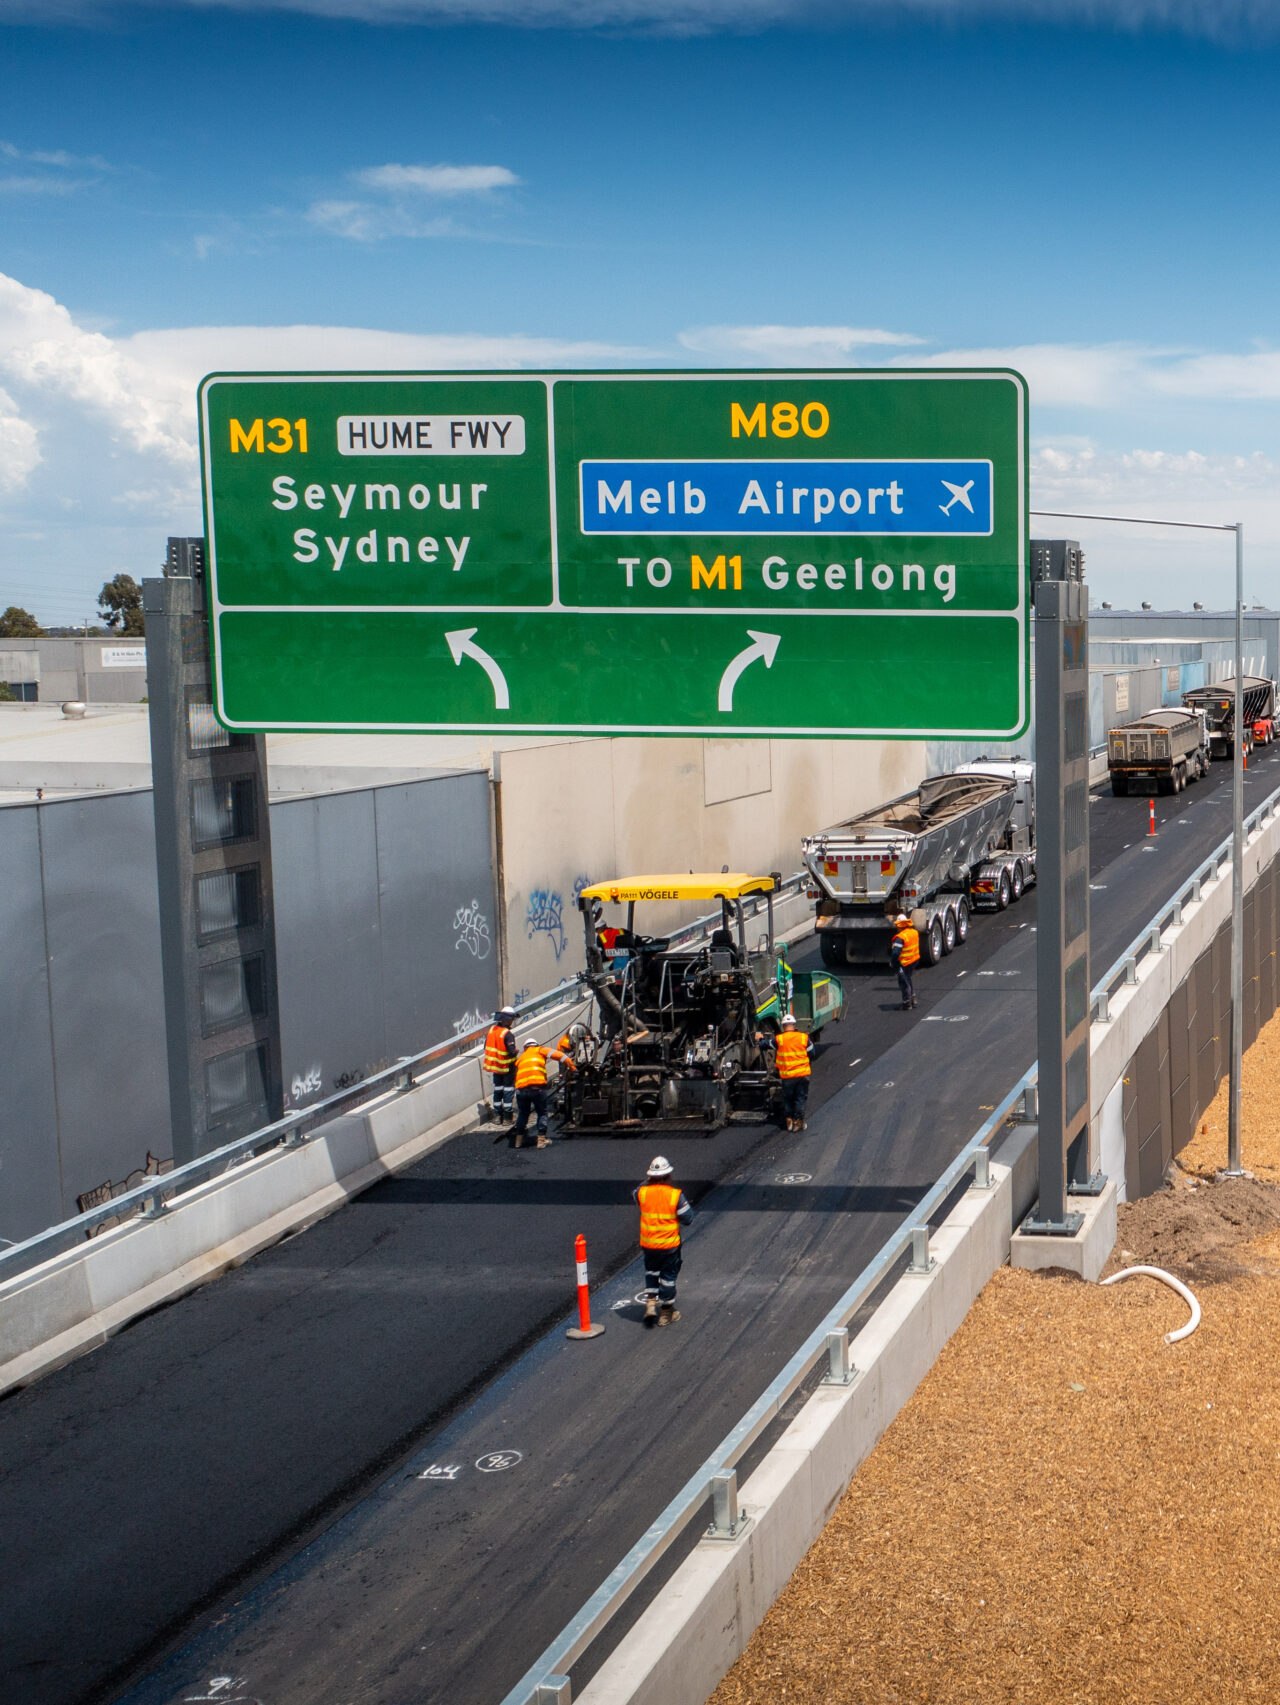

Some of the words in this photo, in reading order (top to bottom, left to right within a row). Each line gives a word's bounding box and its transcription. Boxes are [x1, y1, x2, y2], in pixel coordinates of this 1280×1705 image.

[229, 417, 308, 454] M31
[348, 421, 433, 450] HUME
[450, 421, 512, 449] FWY
[730, 401, 830, 439] M80
[271, 475, 488, 519] Seymour
[597, 480, 706, 514] Melb
[738, 479, 904, 524] Airport
[293, 528, 471, 571] Sydney
[617, 557, 672, 588] TO
[690, 554, 742, 591] M1
[762, 555, 956, 602] Geelong
[639, 888, 679, 899] VÖGELE
